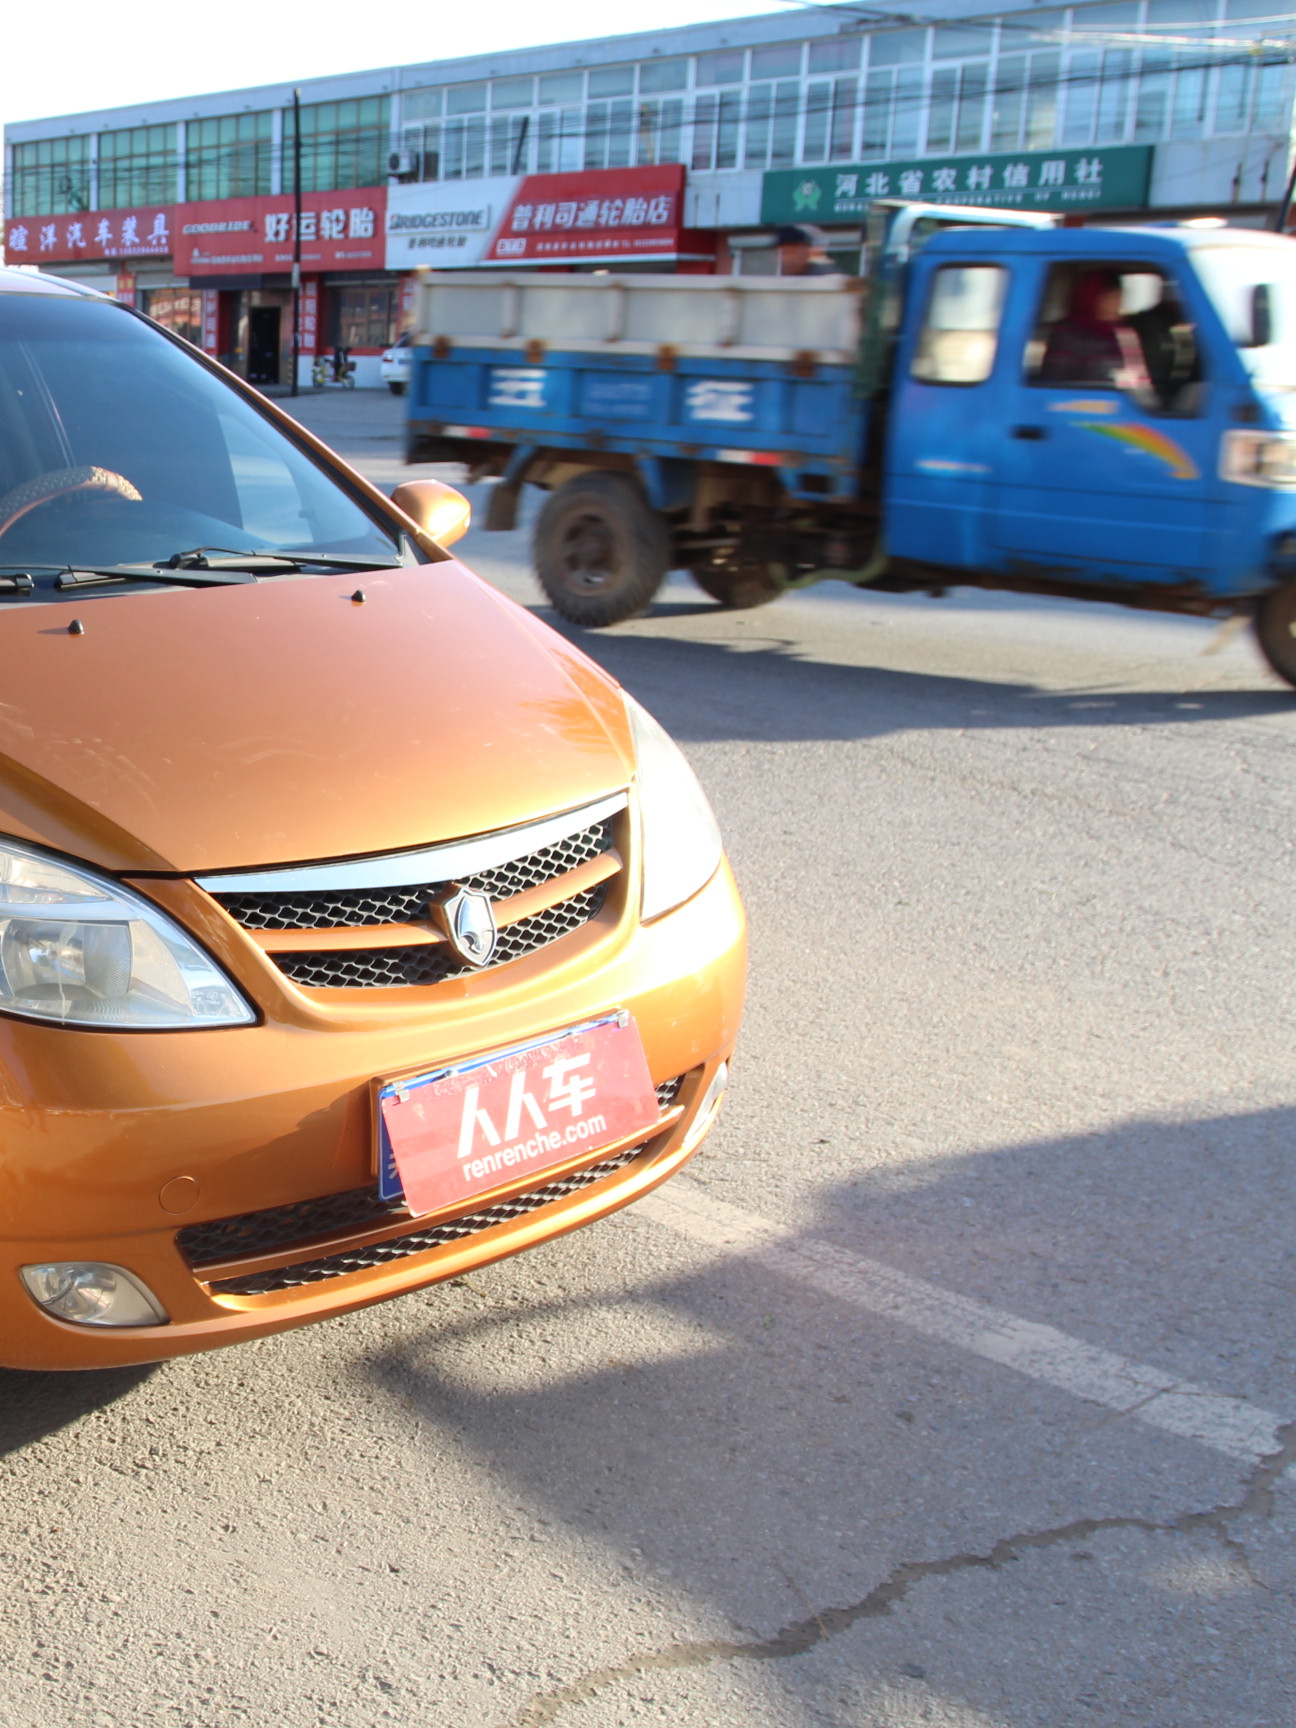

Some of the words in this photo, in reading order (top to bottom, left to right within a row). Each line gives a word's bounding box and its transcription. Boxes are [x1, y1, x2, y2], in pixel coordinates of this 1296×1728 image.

[834, 158, 1102, 198] 河北省农村信用社
[264, 207, 376, 243] 好运轮胎
[389, 210, 484, 231] BRIDGESTONE
[511, 195, 674, 231] 普利司通轮胎店
[456, 1052, 597, 1159] 人人车
[462, 1114, 607, 1182] renrenche.com
